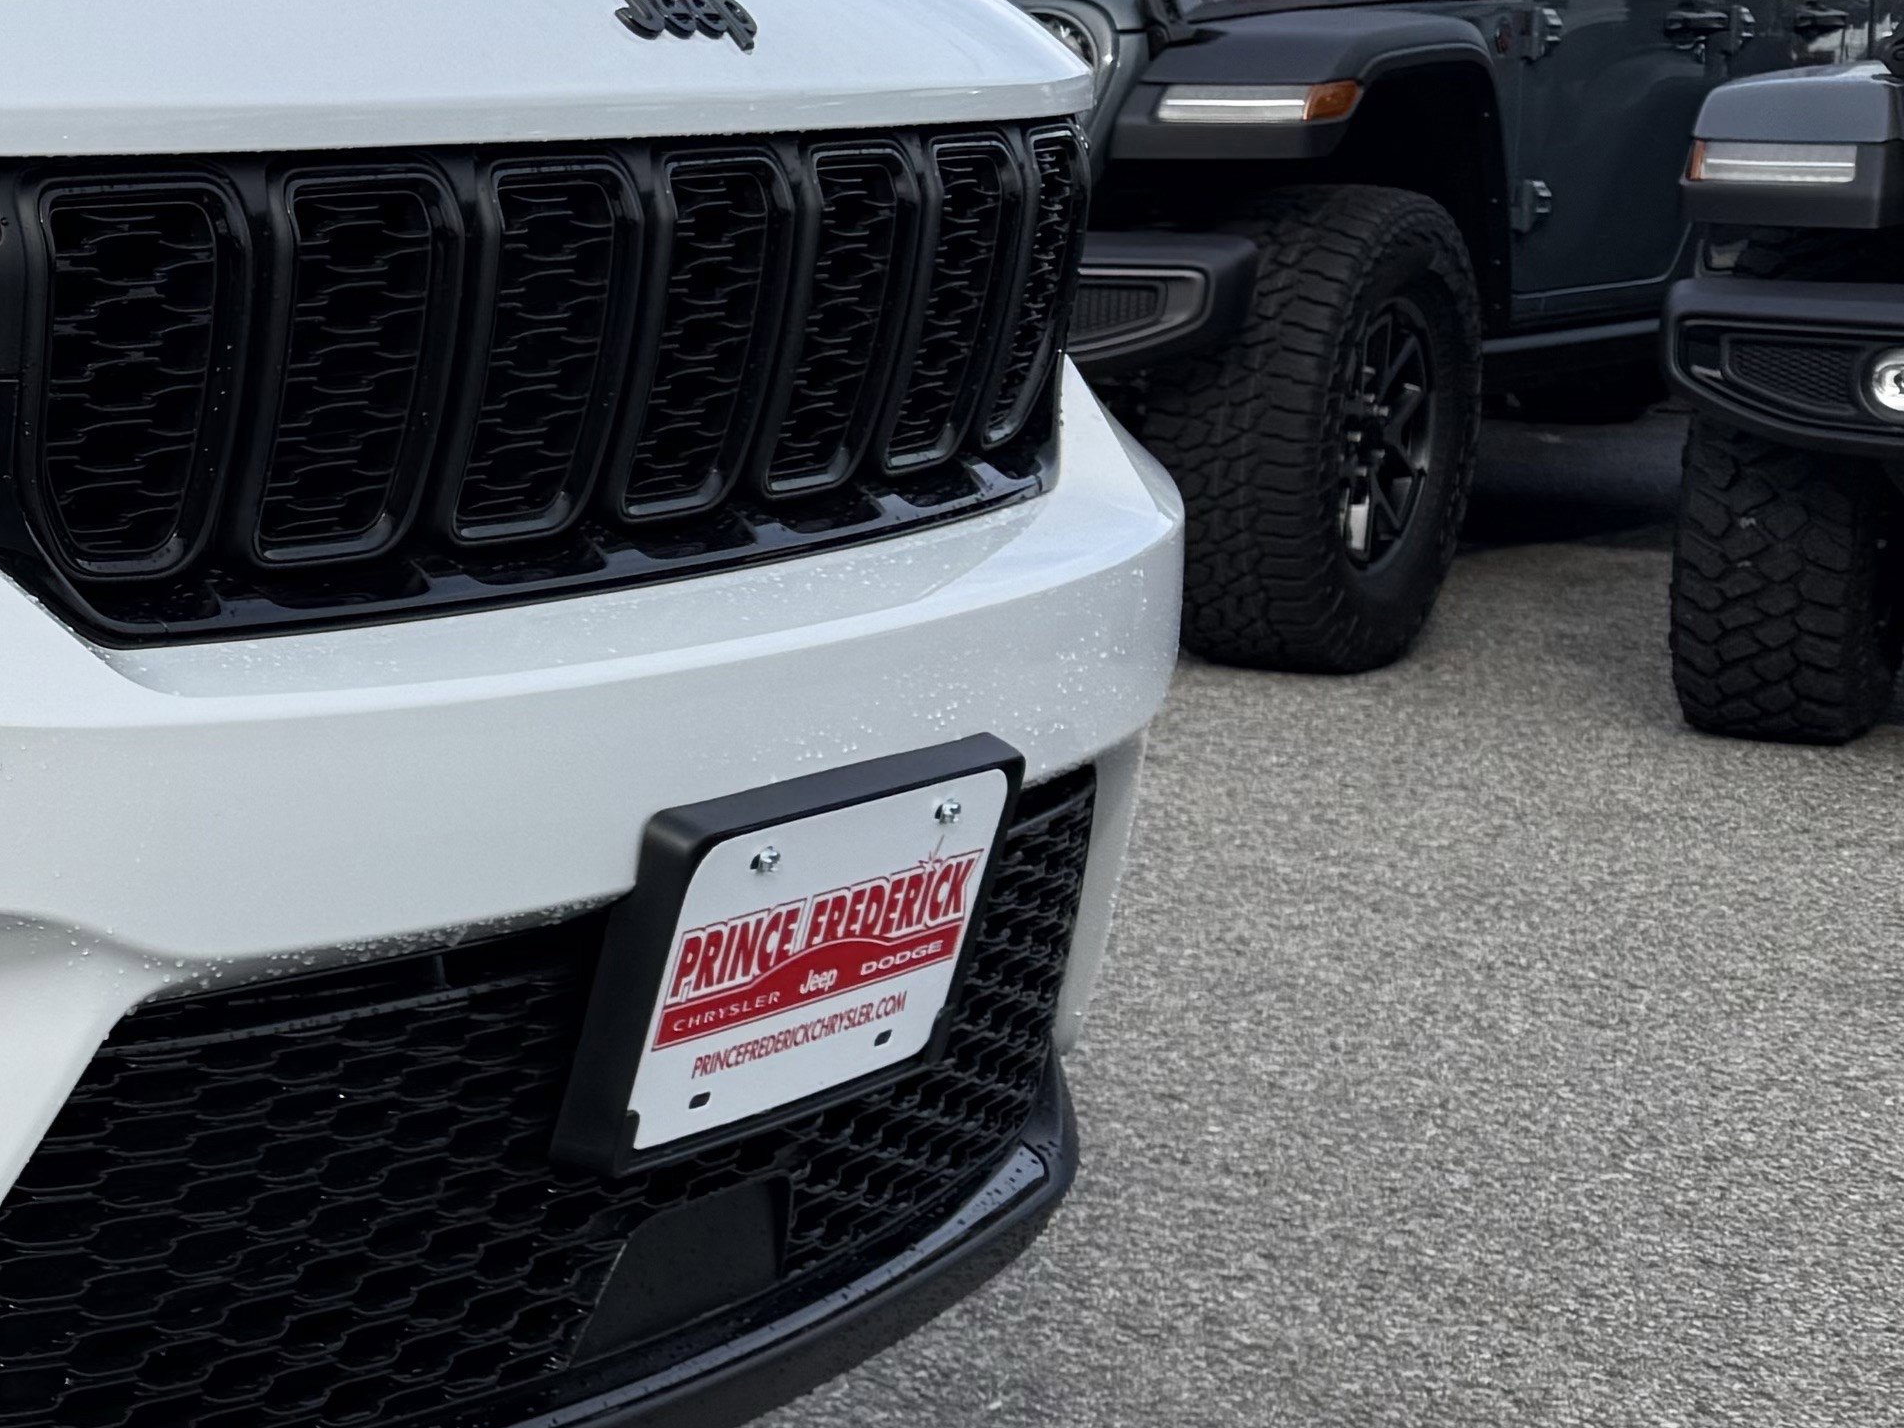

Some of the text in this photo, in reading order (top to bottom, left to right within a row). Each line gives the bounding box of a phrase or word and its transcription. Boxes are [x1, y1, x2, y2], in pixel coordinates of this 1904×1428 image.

[667, 853, 979, 1001] PRINCE FREDERICK
[673, 939, 944, 1033] CHRYSLER Jeep DODGE
[691, 990, 909, 1080] PRINCEFREDERICKCHRYSLER.COM
